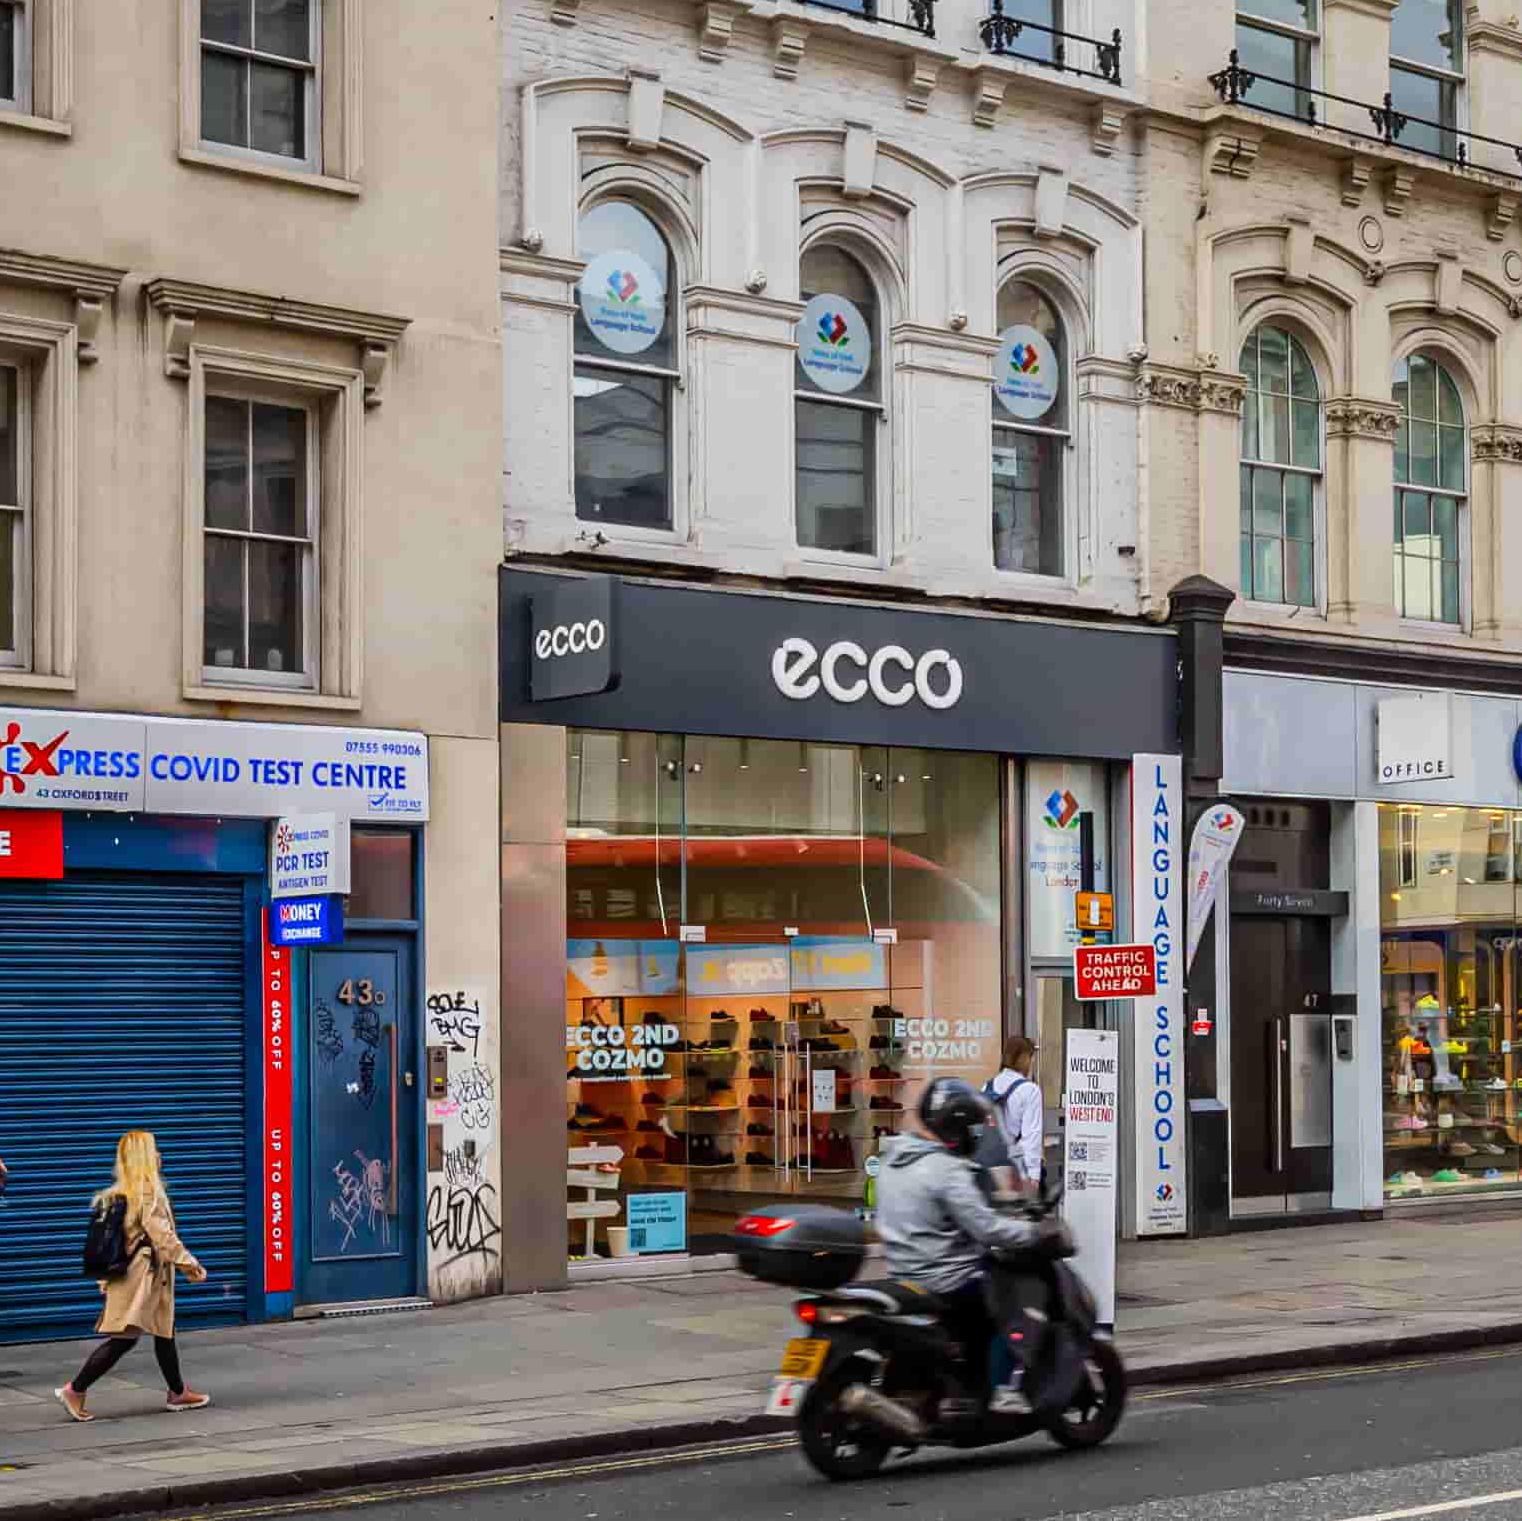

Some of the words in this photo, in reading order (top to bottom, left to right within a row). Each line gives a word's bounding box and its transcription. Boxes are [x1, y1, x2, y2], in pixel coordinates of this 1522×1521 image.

[535, 618, 605, 659] ecco
[772, 637, 963, 709] ecco
[6, 730, 140, 779] EXPRESS
[150, 754, 240, 783] COVID
[249, 759, 304, 785] TEST
[312, 762, 407, 790] CENTRE
[1381, 759, 1447, 780] OFFICE
[276, 855, 298, 871] PCR
[302, 852, 329, 870] TEST
[279, 878, 308, 888] ANTIGEN
[311, 876, 327, 887] TEST
[1153, 765, 1171, 985] LANGUAGE
[280, 903, 321, 922] MONEY
[1087, 951, 1145, 965] TRAFFIC
[271, 968, 281, 990] TO
[1082, 965, 1151, 978] CONTROL
[337, 978, 373, 1006] 43
[1091, 978, 1141, 991] AHEAD
[566, 1025, 624, 1048] ECCO
[631, 1023, 679, 1045] 2ND
[893, 1019, 950, 1039] ECCO
[271, 1035, 282, 1070] OFF
[578, 1047, 664, 1070] COZMO
[908, 1040, 979, 1060] COZMO
[1070, 1057, 1115, 1074] WELCOME
[1087, 1074, 1098, 1089] TO
[1154, 1005, 1173, 1170] SCHOOL
[1070, 1090, 1114, 1106] LONDON'S
[1070, 1107, 1095, 1121] WEST
[1097, 1108, 1114, 1122] END
[271, 1129, 281, 1150] UP
[271, 1160, 281, 1183] TO
[271, 1227, 282, 1262] OFF
